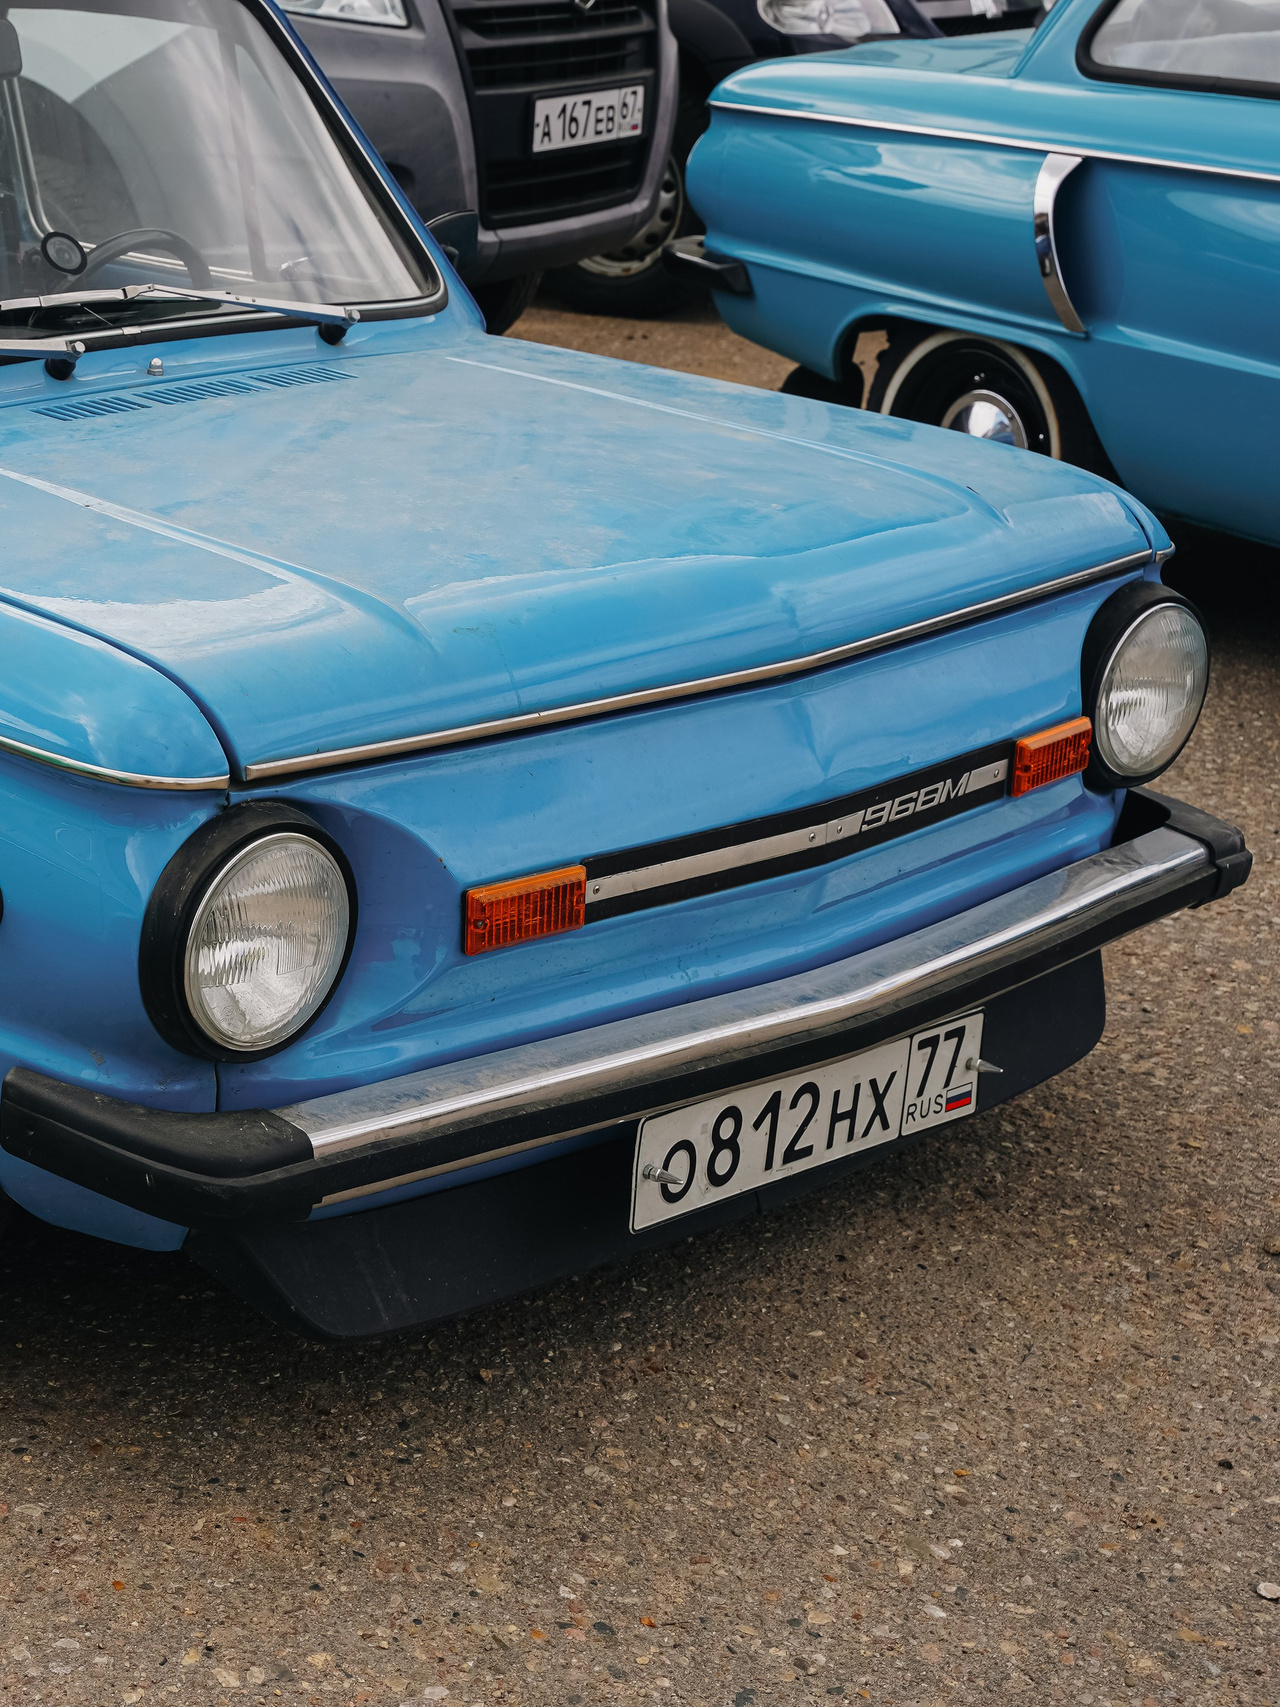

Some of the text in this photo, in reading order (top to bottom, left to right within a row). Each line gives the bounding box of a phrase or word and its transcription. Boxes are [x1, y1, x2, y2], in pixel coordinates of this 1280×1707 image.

[620, 91, 637, 119] 67
[862, 773, 970, 832] 968М
[917, 1026, 966, 1097] 77
[905, 1093, 943, 1125] RUS
